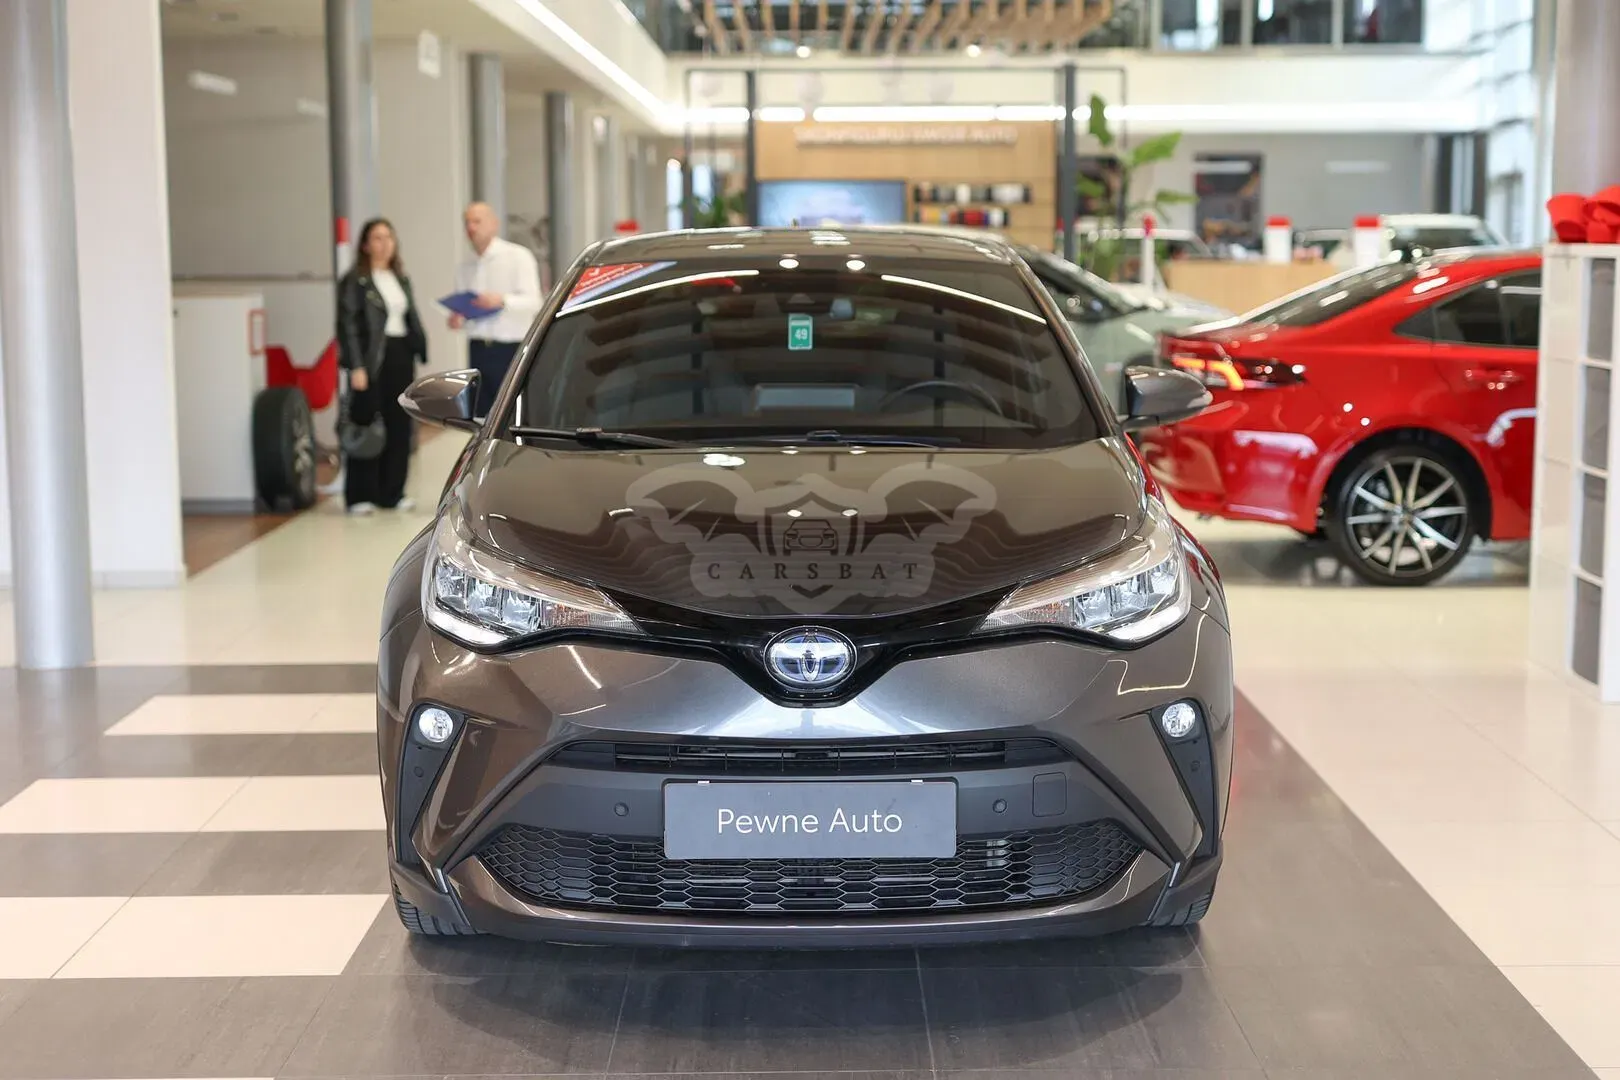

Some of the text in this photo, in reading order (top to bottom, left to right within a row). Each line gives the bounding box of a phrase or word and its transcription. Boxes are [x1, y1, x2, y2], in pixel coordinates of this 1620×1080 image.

[794, 327, 808, 340] 49
[717, 807, 903, 834] Pewne Auto
